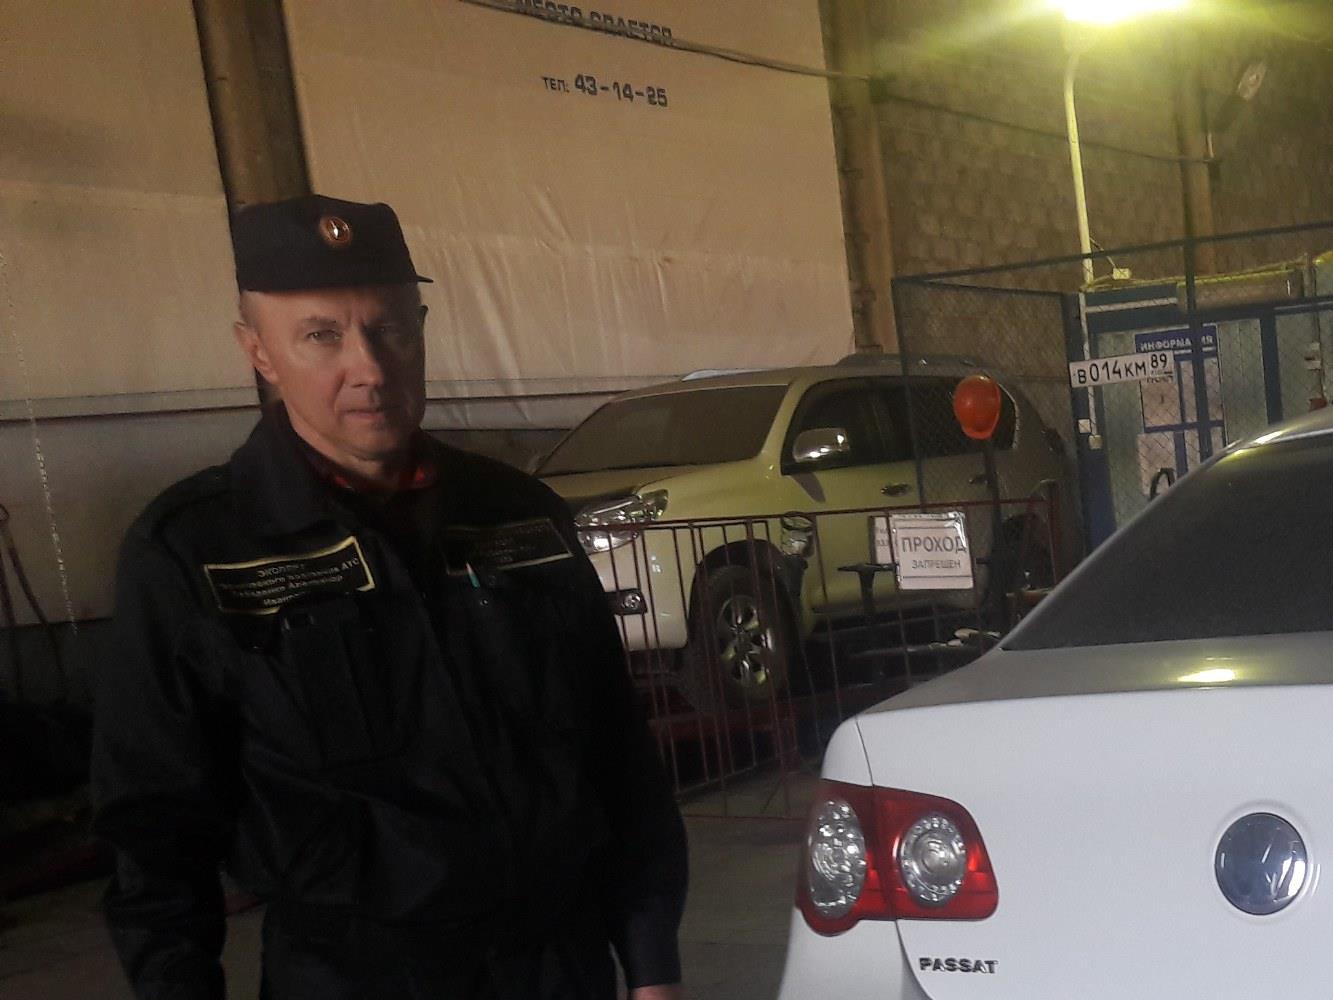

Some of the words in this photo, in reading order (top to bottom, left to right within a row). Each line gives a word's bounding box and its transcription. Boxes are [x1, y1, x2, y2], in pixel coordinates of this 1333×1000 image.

[574, 74, 668, 107] 43-14-25
[1140, 335, 1213, 352] ИНФОРМАИЯ
[1077, 360, 1147, 384] В014КМ
[1150, 353, 1167, 369] 89
[901, 536, 967, 555] ПРОХОД
[919, 957, 998, 974] PASSAT
